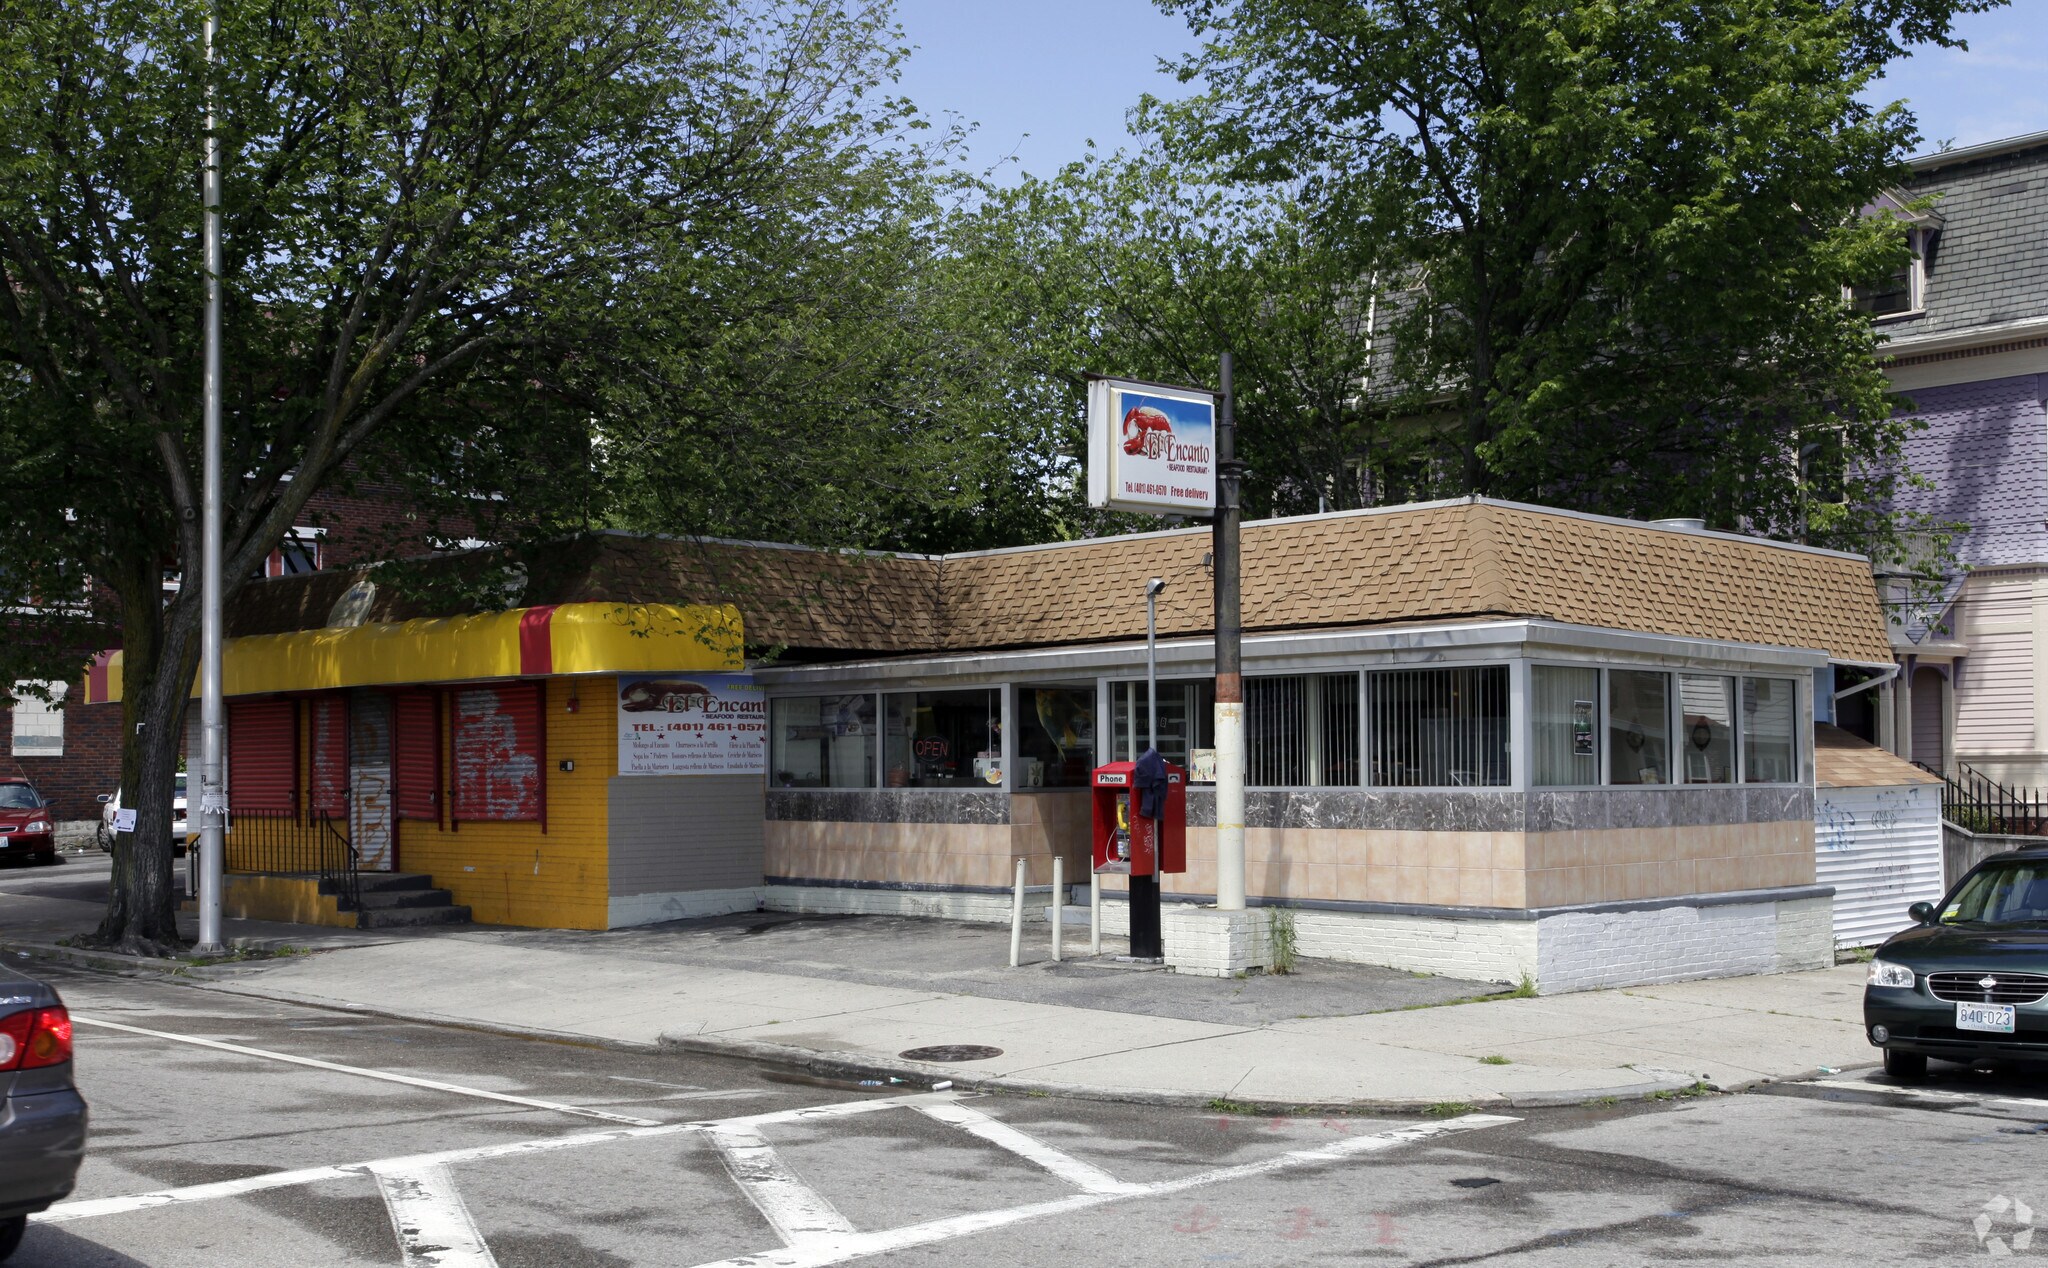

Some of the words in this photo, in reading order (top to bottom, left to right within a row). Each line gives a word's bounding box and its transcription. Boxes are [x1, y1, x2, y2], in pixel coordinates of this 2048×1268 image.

[1145, 432, 1161, 460] El
[1164, 434, 1210, 464] Encanto
[1168, 463, 1185, 472] SEAFOOD
[1186, 465, 1208, 474] RESTAURANT
[1134, 482, 1146, 494] (401)
[1146, 483, 1167, 496] 461-0570
[1170, 486, 1184, 498] Free
[1185, 487, 1209, 501] delivery
[662, 695, 690, 713] El
[667, 723, 704, 731] (401)
[915, 740, 949, 757] OPEN
[1100, 775, 1123, 783] Phone
[1960, 1009, 2010, 1026] 840-023
